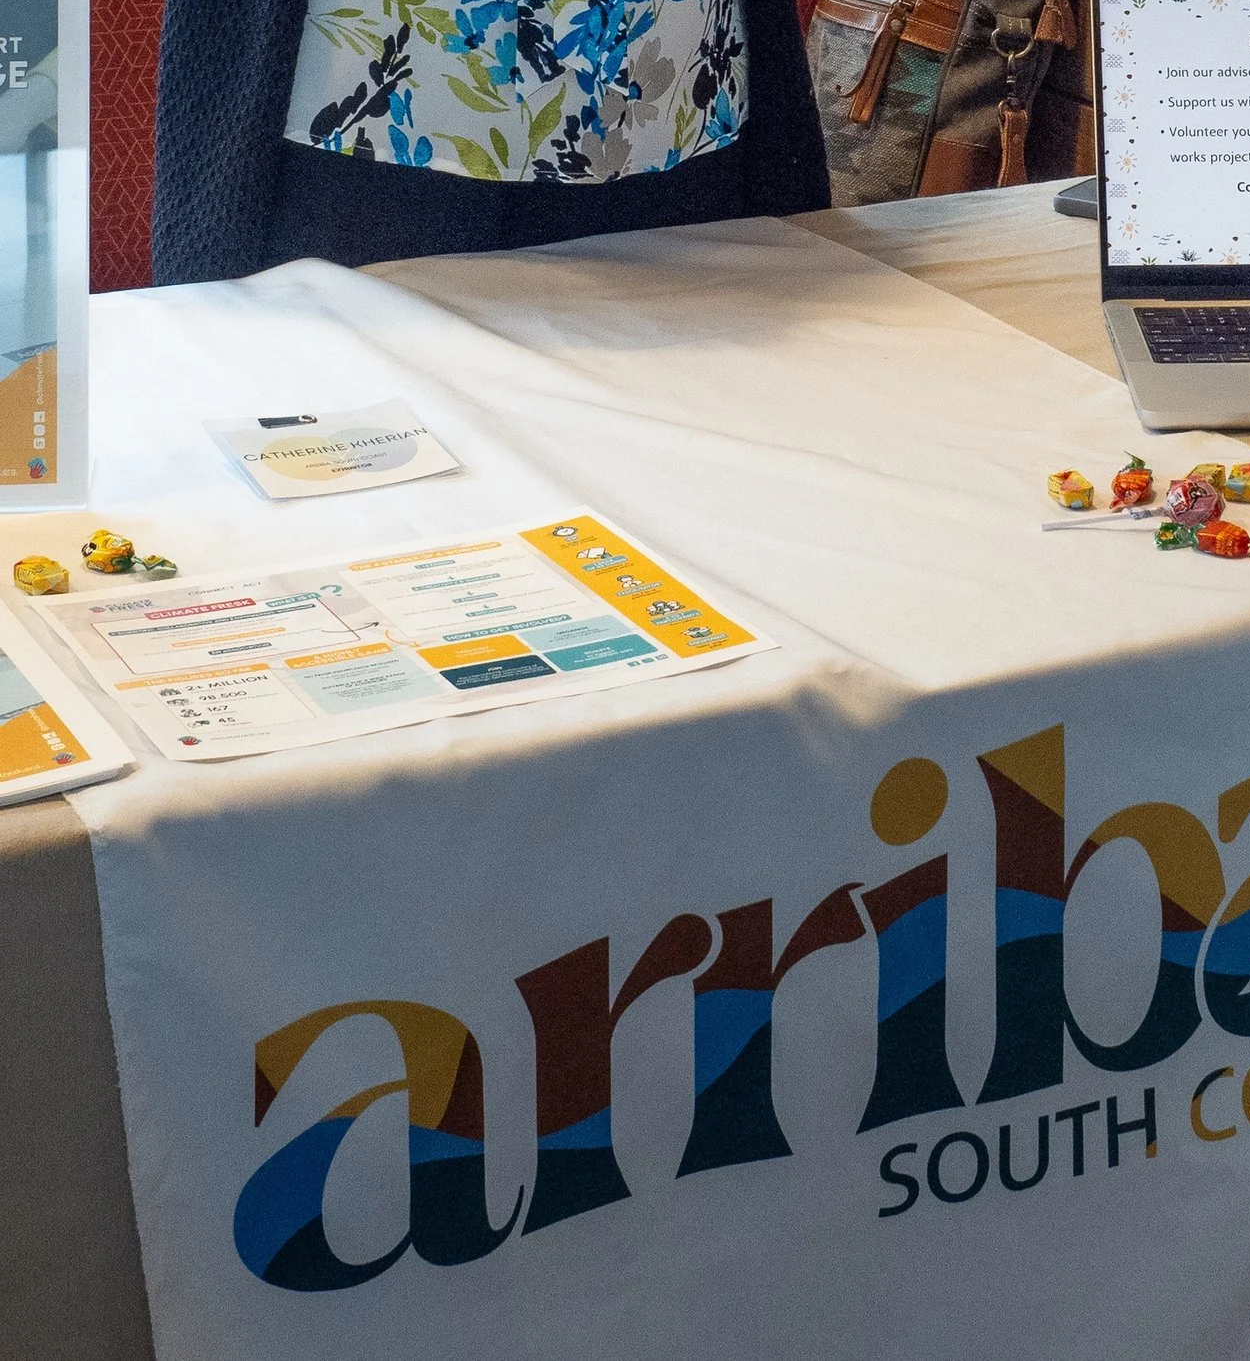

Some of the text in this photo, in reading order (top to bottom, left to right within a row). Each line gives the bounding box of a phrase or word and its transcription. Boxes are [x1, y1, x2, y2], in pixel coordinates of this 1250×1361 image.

[1165, 66, 1189, 80] Join
[1192, 68, 1214, 78] our
[1168, 96, 1217, 111] Support
[1220, 98, 1235, 108] us
[1169, 125, 1229, 138] Volunteer
[1169, 150, 1207, 164] works
[244, 426, 428, 463] CATHERINE KHERIAN
[150, 599, 251, 620] CLIMATE FRESK
[208, 674, 269, 689] MILLION
[878, 1087, 1158, 1218] SOUTH
